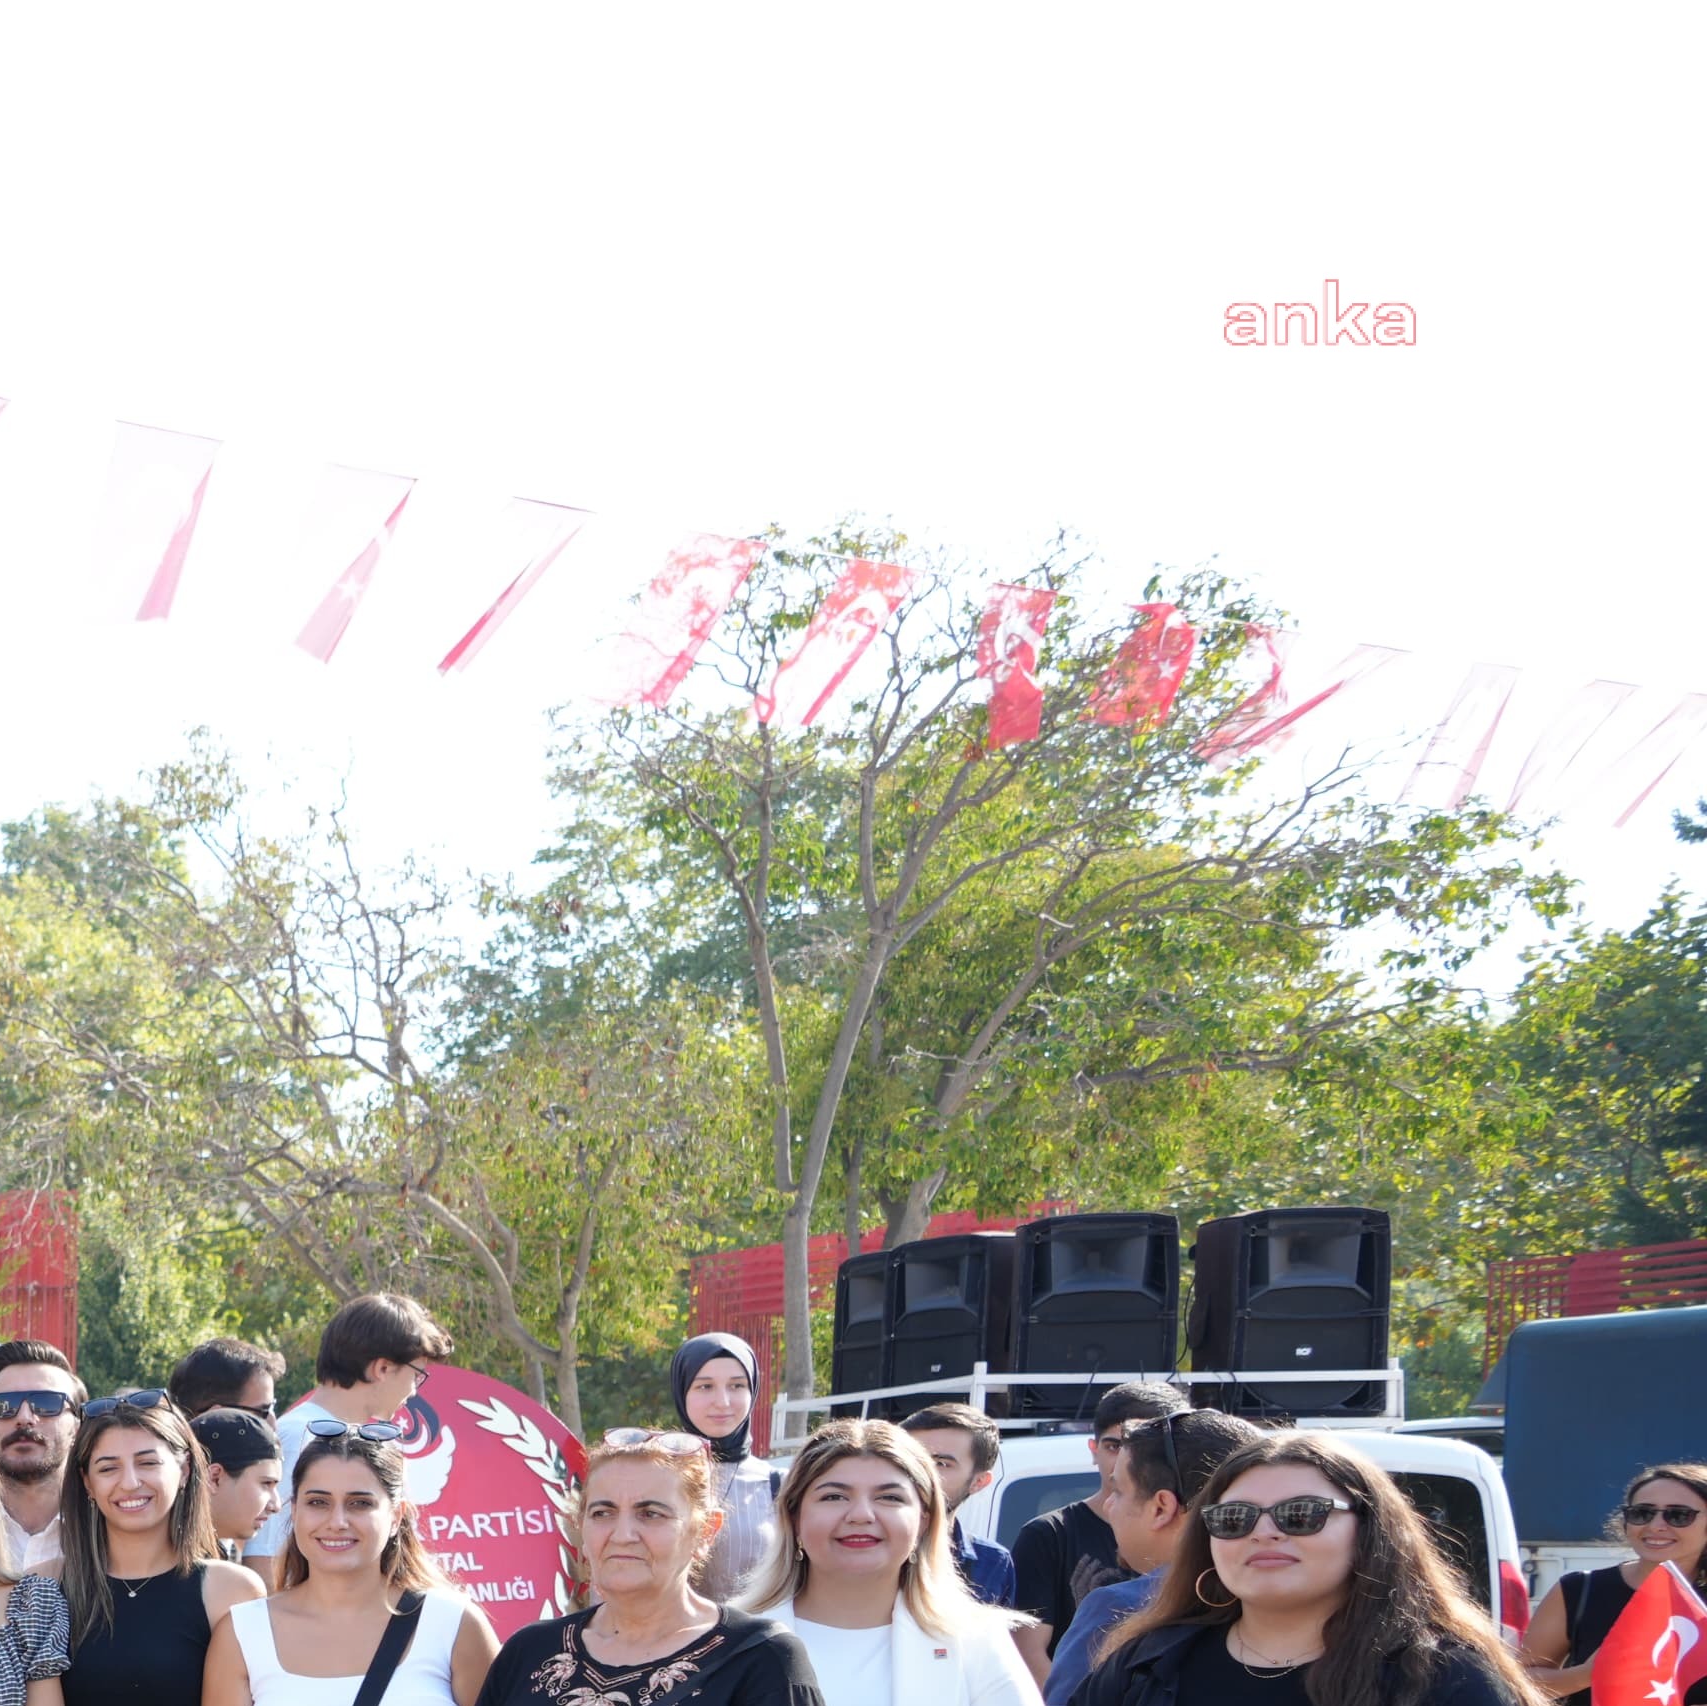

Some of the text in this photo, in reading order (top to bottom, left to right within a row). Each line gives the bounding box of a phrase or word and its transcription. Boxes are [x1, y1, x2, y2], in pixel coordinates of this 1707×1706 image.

[429, 1505, 554, 1541] PARTİSİ
[433, 1551, 483, 1573] TAL
[465, 1576, 536, 1603] ANLIĞI
